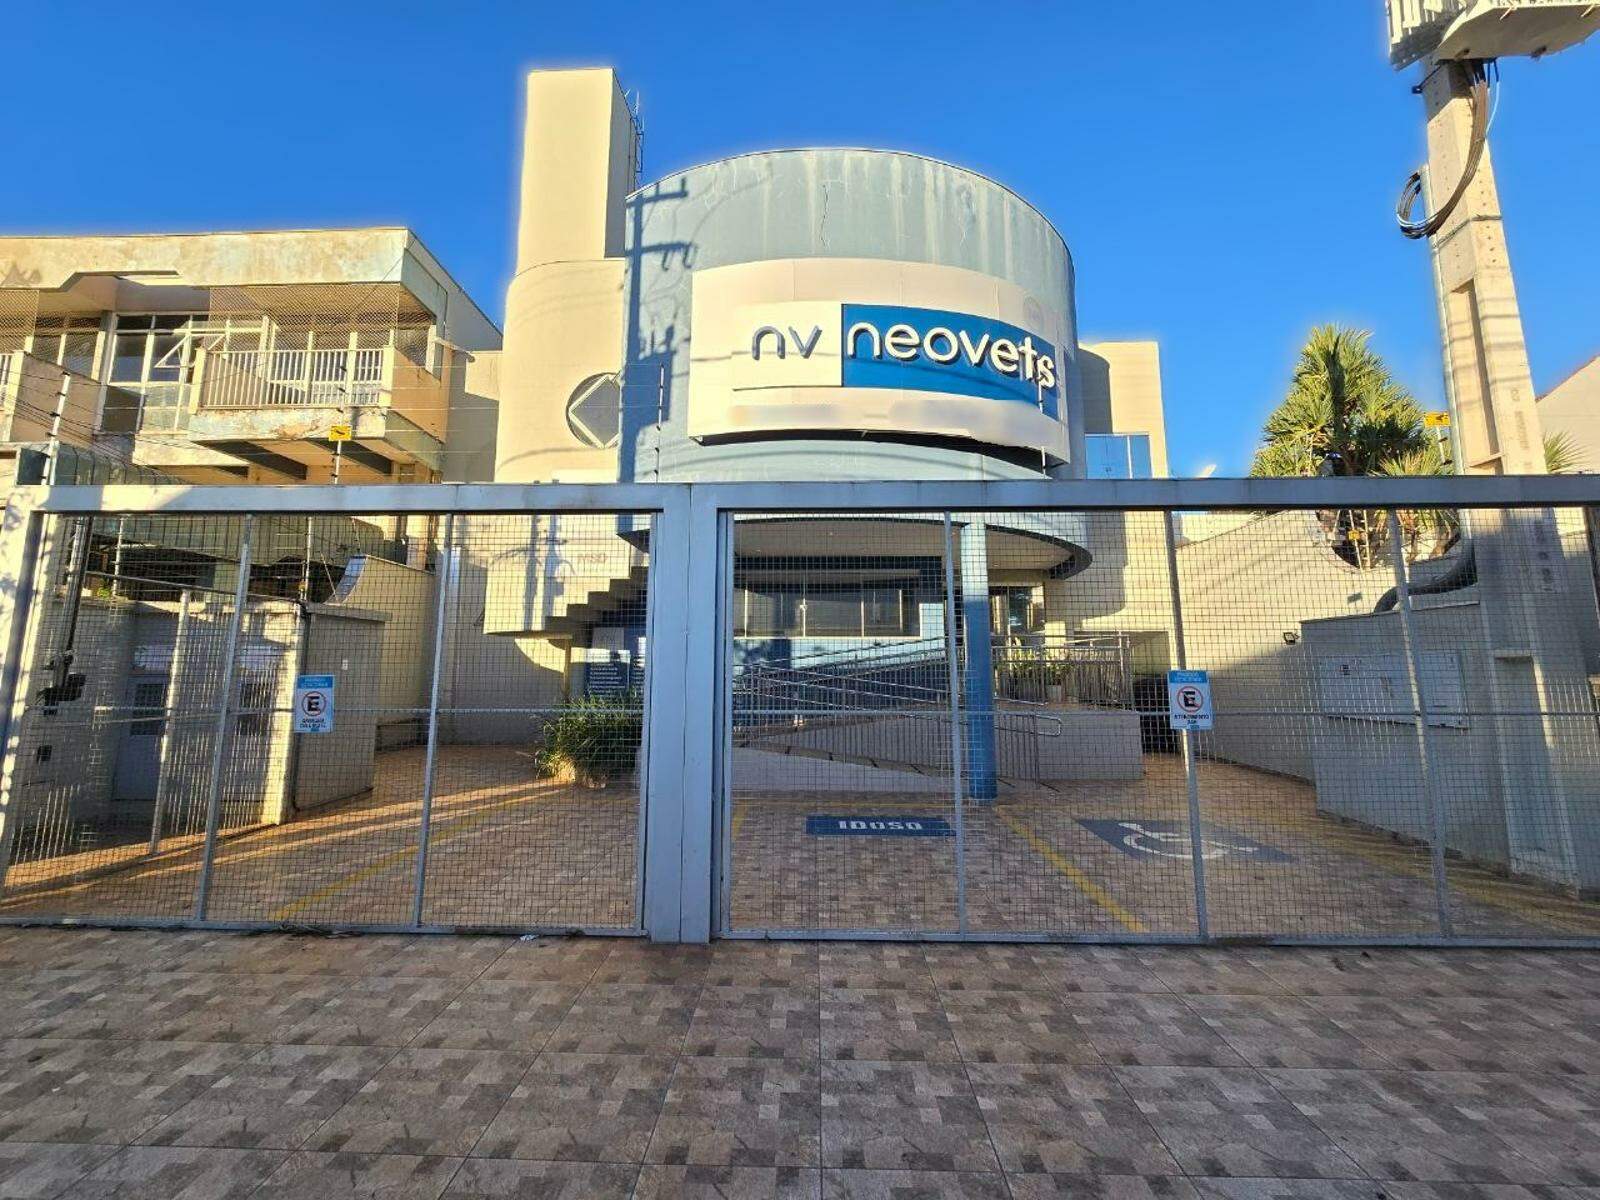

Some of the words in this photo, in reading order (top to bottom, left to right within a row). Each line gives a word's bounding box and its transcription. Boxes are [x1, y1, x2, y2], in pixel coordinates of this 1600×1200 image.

[752, 324, 823, 361] nv
[847, 321, 1056, 389] neovets
[838, 820, 923, 830] IDOSO
